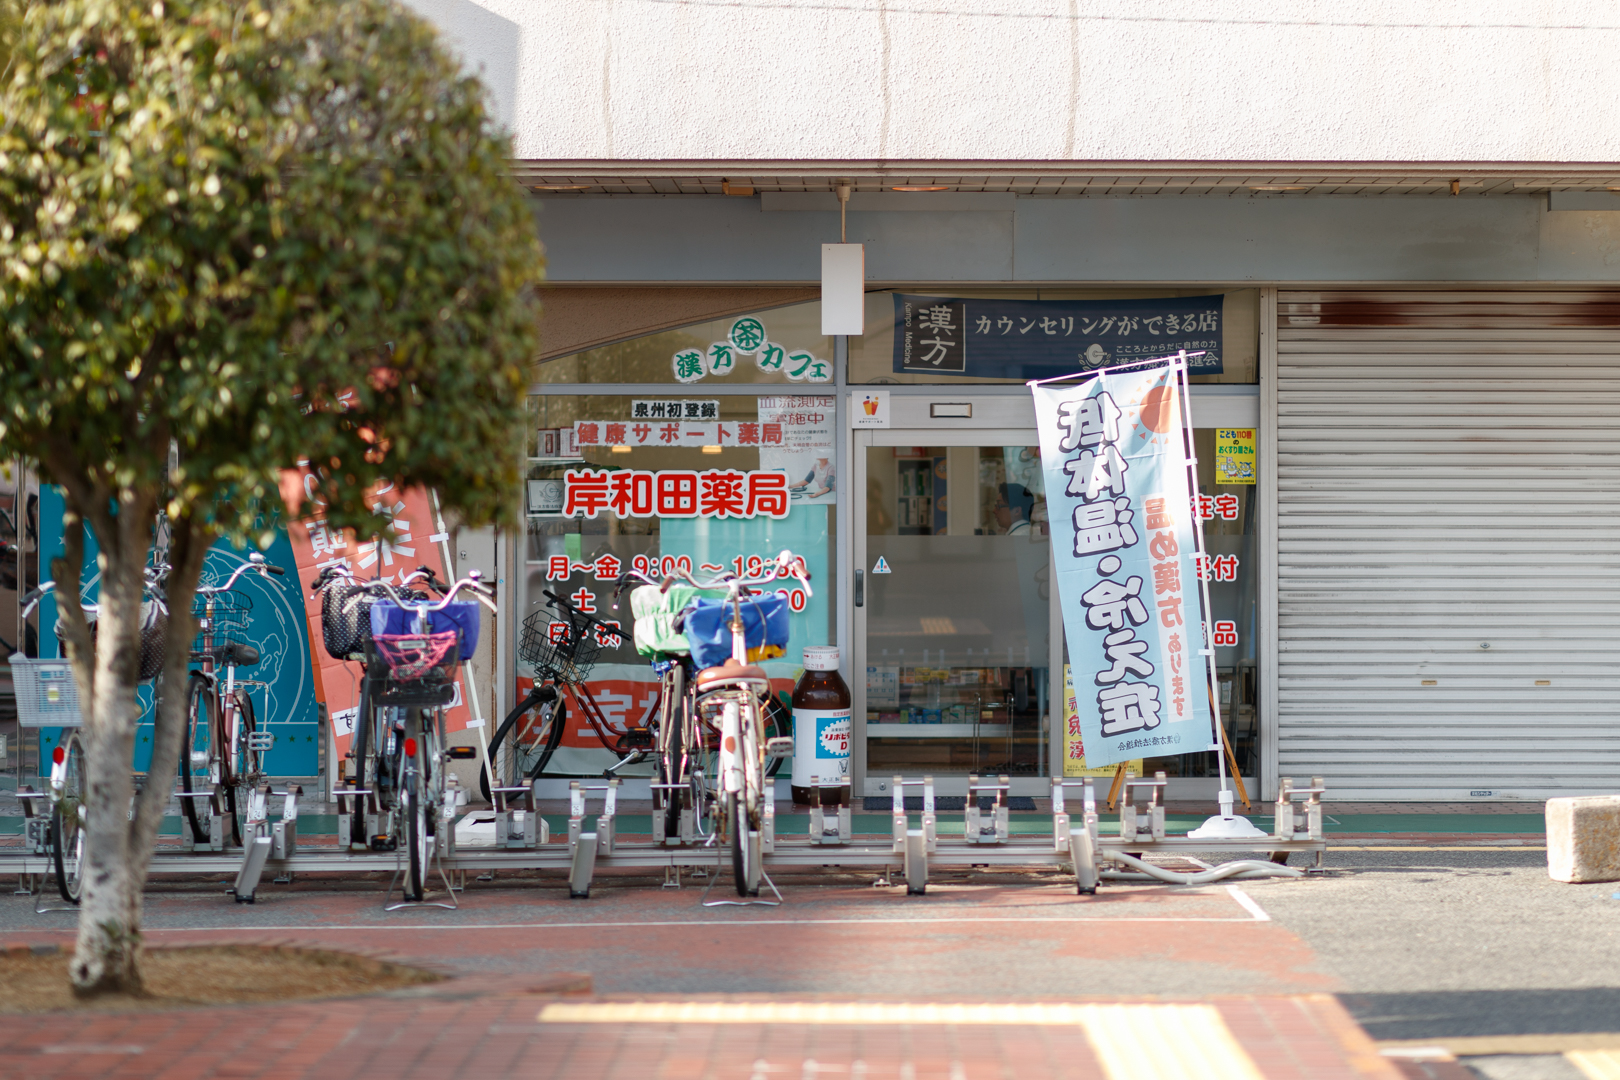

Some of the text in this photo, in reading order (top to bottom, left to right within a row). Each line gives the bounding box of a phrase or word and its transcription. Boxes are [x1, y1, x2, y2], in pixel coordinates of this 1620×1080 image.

[903, 302, 913, 364] Kampo Medicine
[918, 305, 957, 366] 漢方
[975, 310, 1219, 337] カウンセリングができる店
[1116, 340, 1217, 354] こころとからだに自然の力
[635, 402, 717, 418] 泉州初登録
[760, 395, 834, 409] 血流測定
[577, 422, 783, 445] 健康サポート薬局
[565, 472, 788, 516] 岸和田薬局
[633, 556, 691, 580] 9:00
[572, 588, 595, 612] 土
[840, 741, 848, 750] D
